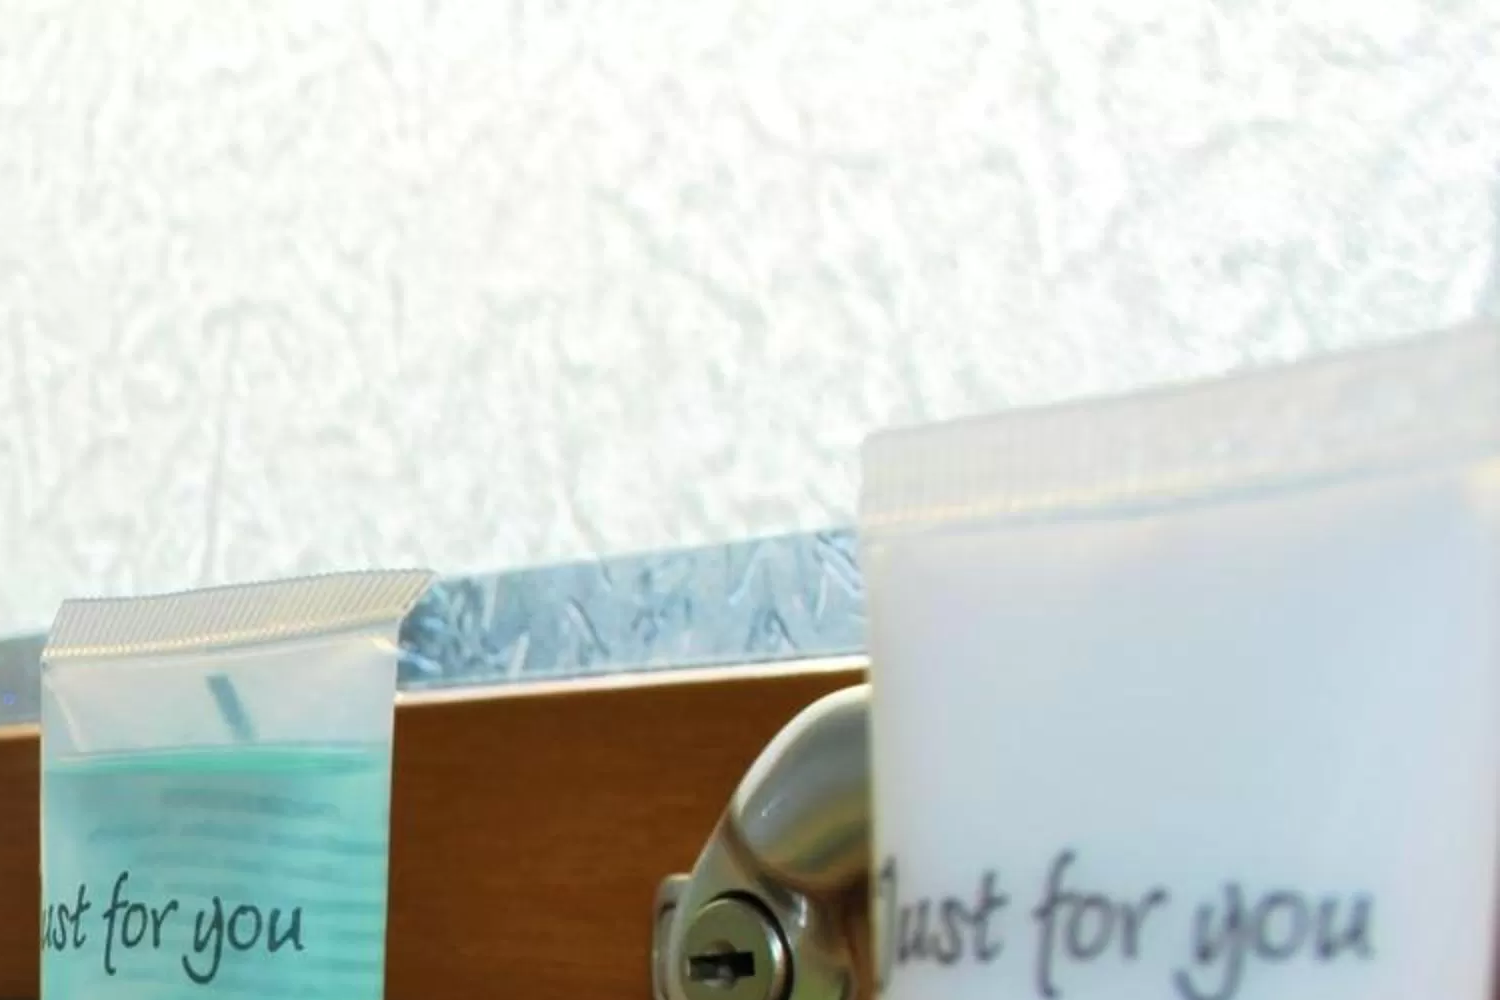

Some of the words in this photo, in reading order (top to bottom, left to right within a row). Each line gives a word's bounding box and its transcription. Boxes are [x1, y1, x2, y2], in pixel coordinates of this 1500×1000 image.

[41, 883, 92, 951] ust
[102, 870, 179, 976] for
[181, 896, 304, 984] you
[1034, 849, 1167, 1000] for
